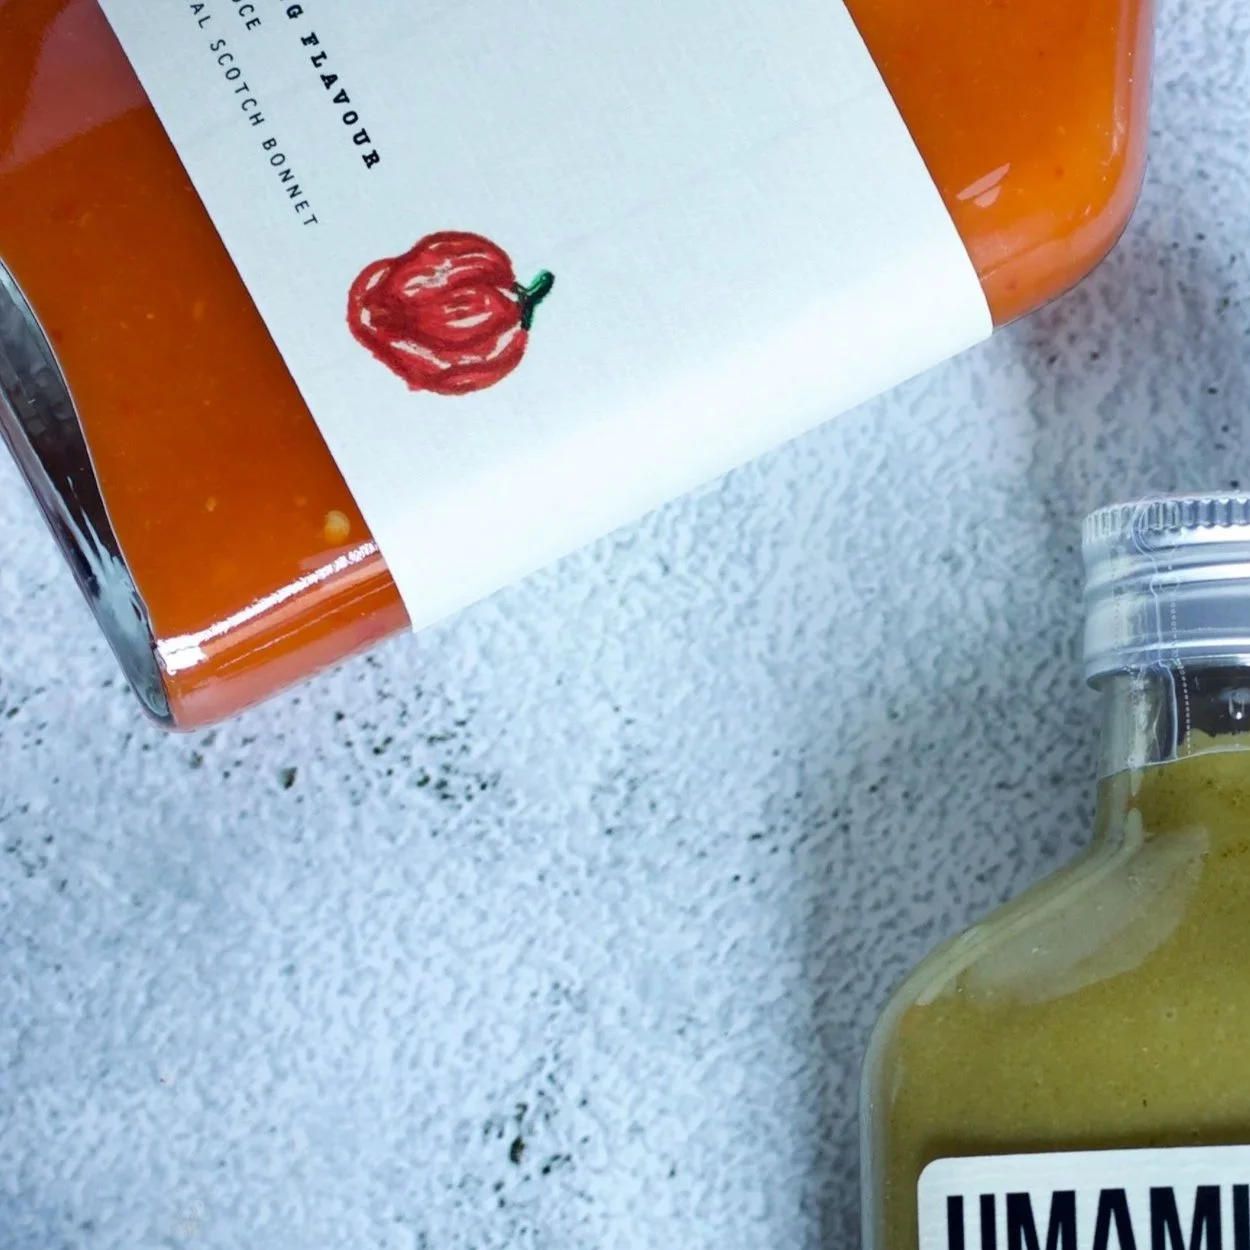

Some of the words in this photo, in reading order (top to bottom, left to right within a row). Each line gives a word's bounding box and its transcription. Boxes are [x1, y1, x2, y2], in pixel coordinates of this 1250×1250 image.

[209, 38, 265, 127] SCOTCH
[261, 137, 318, 226] BONNET
[300, 31, 381, 170] FLAVOUR
